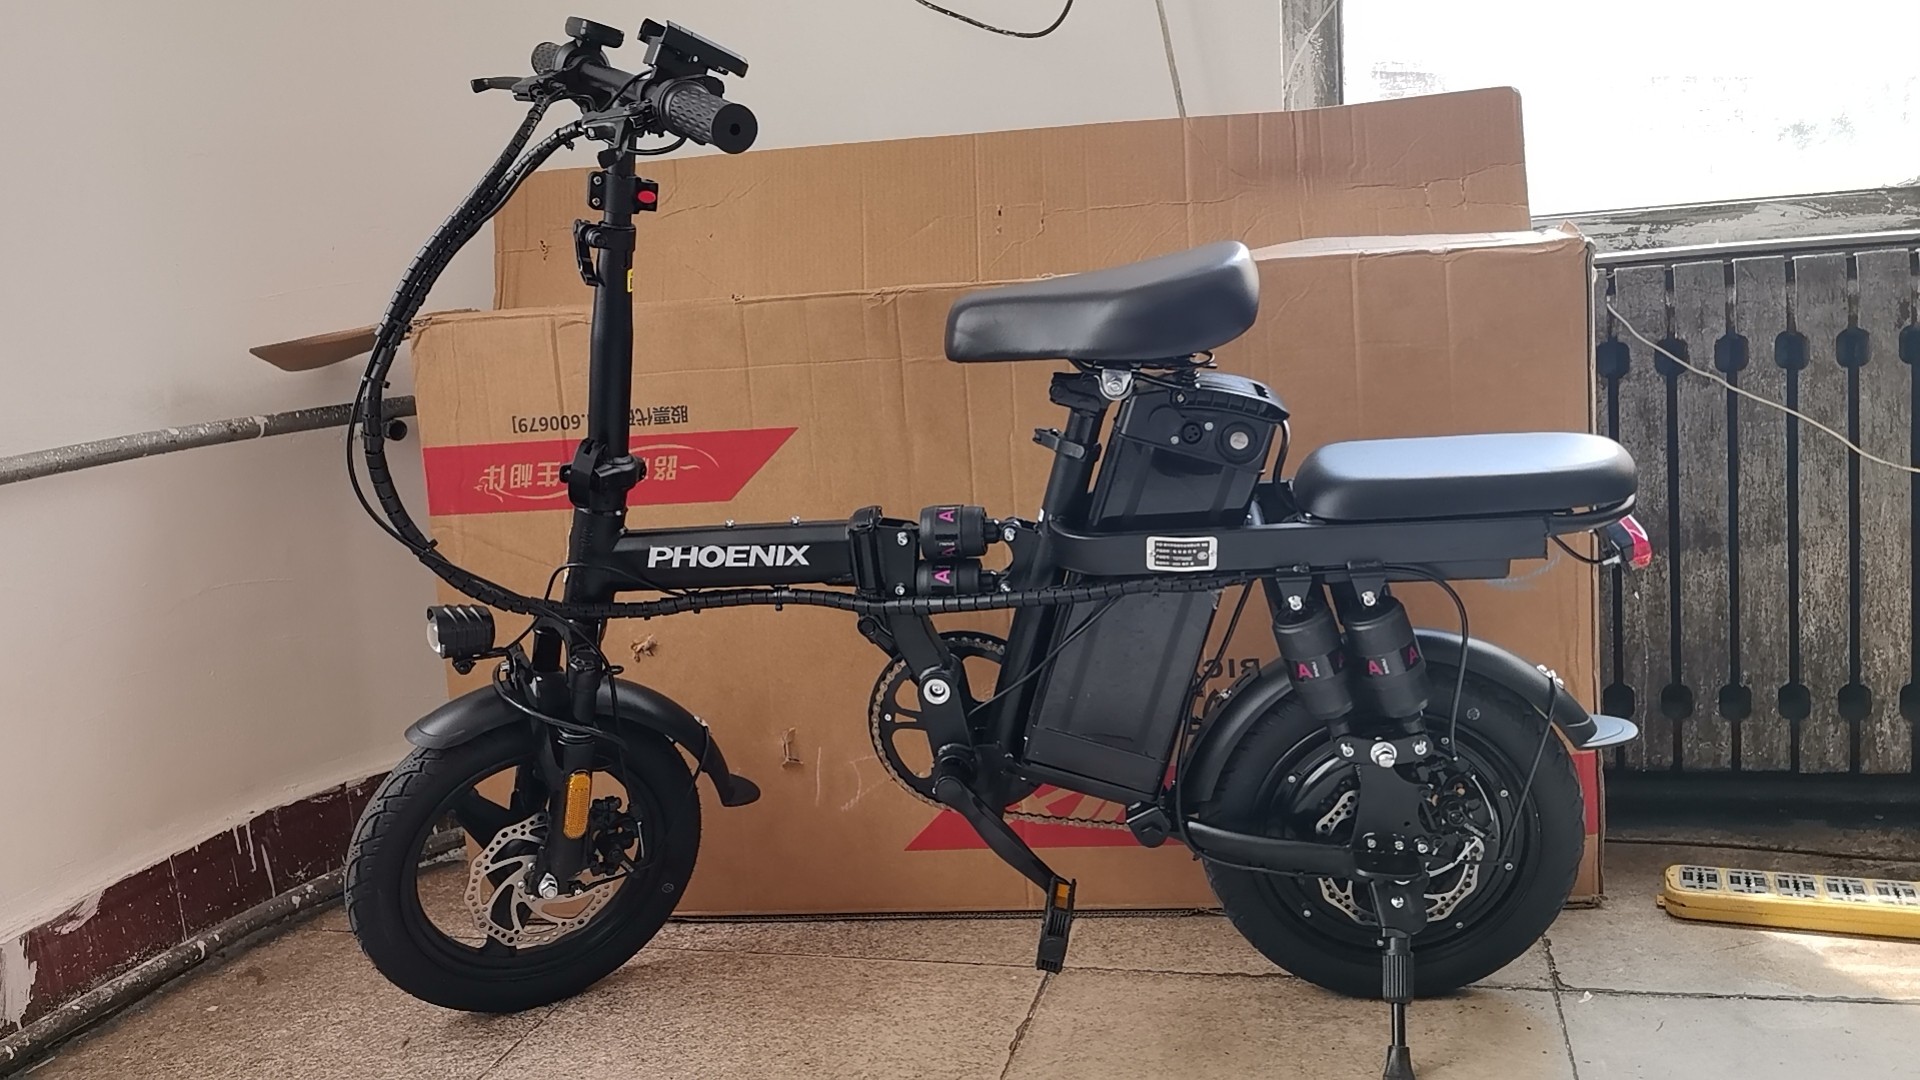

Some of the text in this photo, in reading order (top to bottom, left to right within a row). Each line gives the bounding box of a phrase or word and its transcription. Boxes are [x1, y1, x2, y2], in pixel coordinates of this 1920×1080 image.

[512, 413, 588, 434] .600679]
[484, 455, 701, 490] 一路 生相伴
[647, 545, 811, 568] PHOENIX
